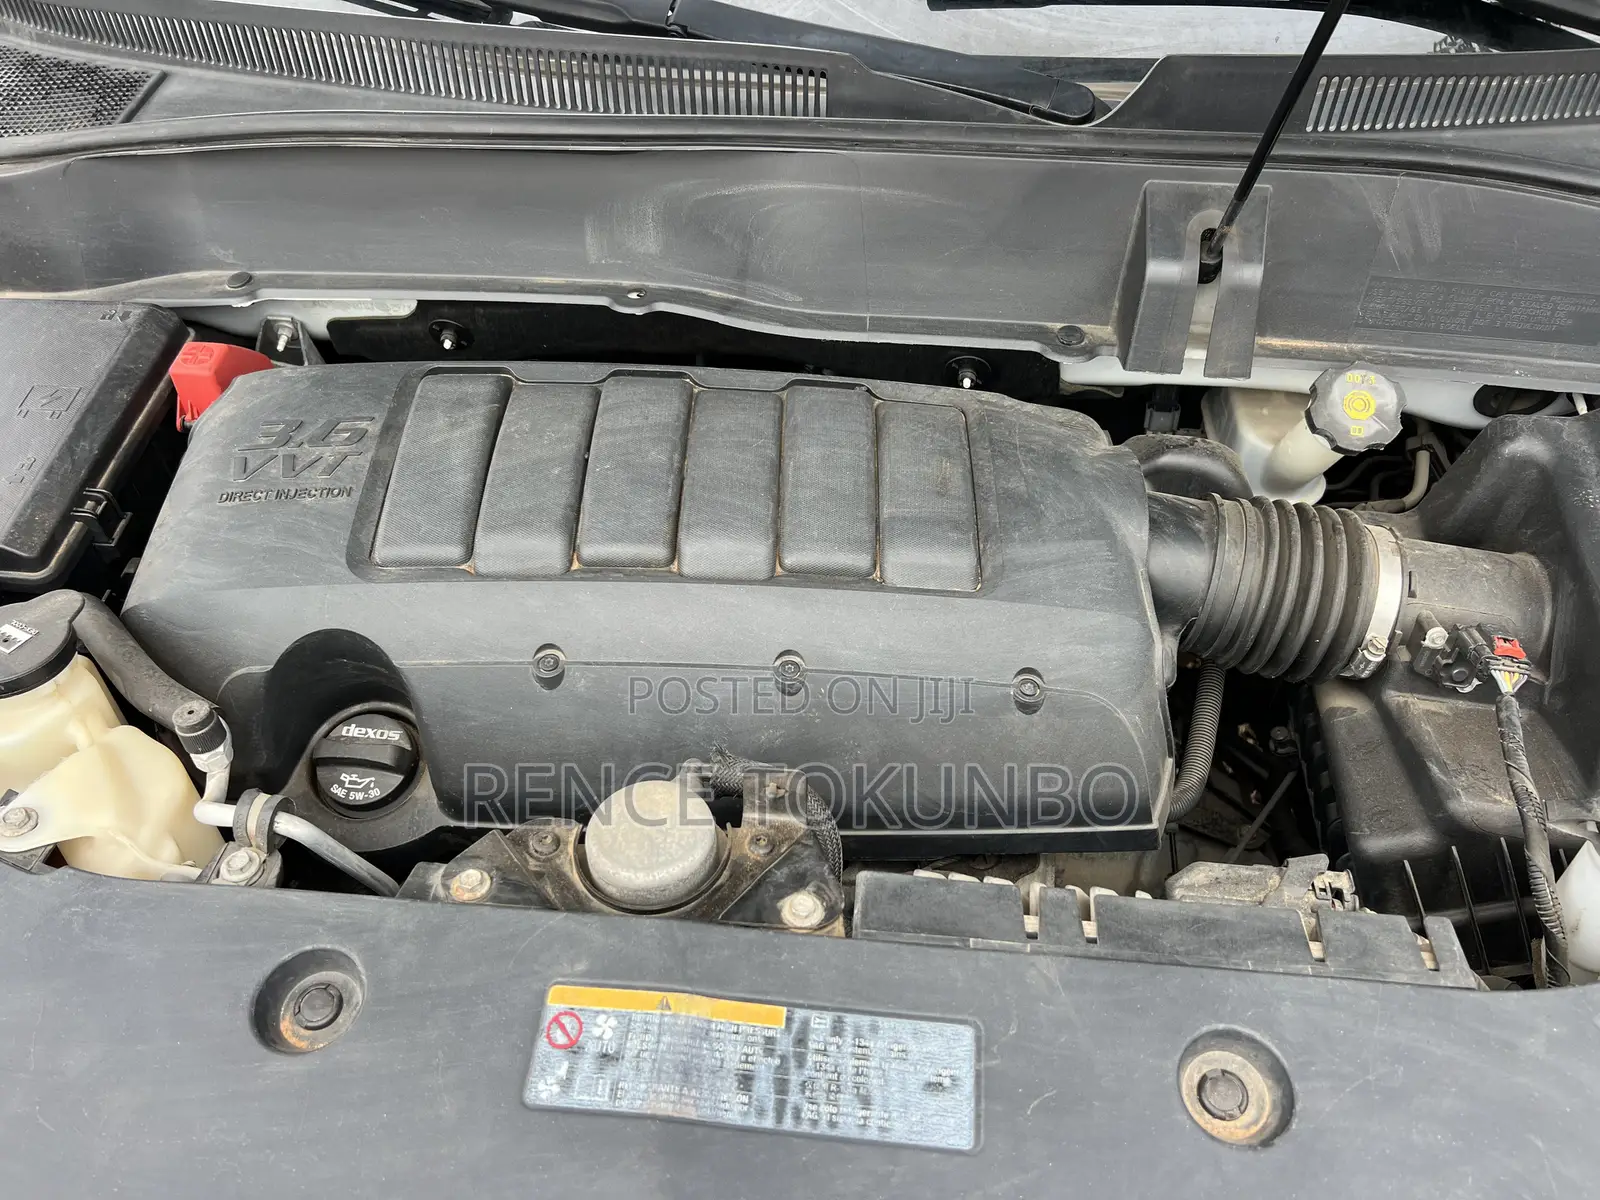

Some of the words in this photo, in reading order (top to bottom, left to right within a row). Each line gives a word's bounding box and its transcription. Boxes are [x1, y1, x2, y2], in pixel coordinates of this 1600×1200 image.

[237, 416, 375, 451] 3.6
[233, 451, 363, 482] VVT
[217, 490, 273, 504] DIRECT
[274, 486, 353, 501] INJECTION
[341, 723, 403, 741] dexos
[330, 784, 348, 798] SAE
[349, 788, 381, 800] 5W-30
